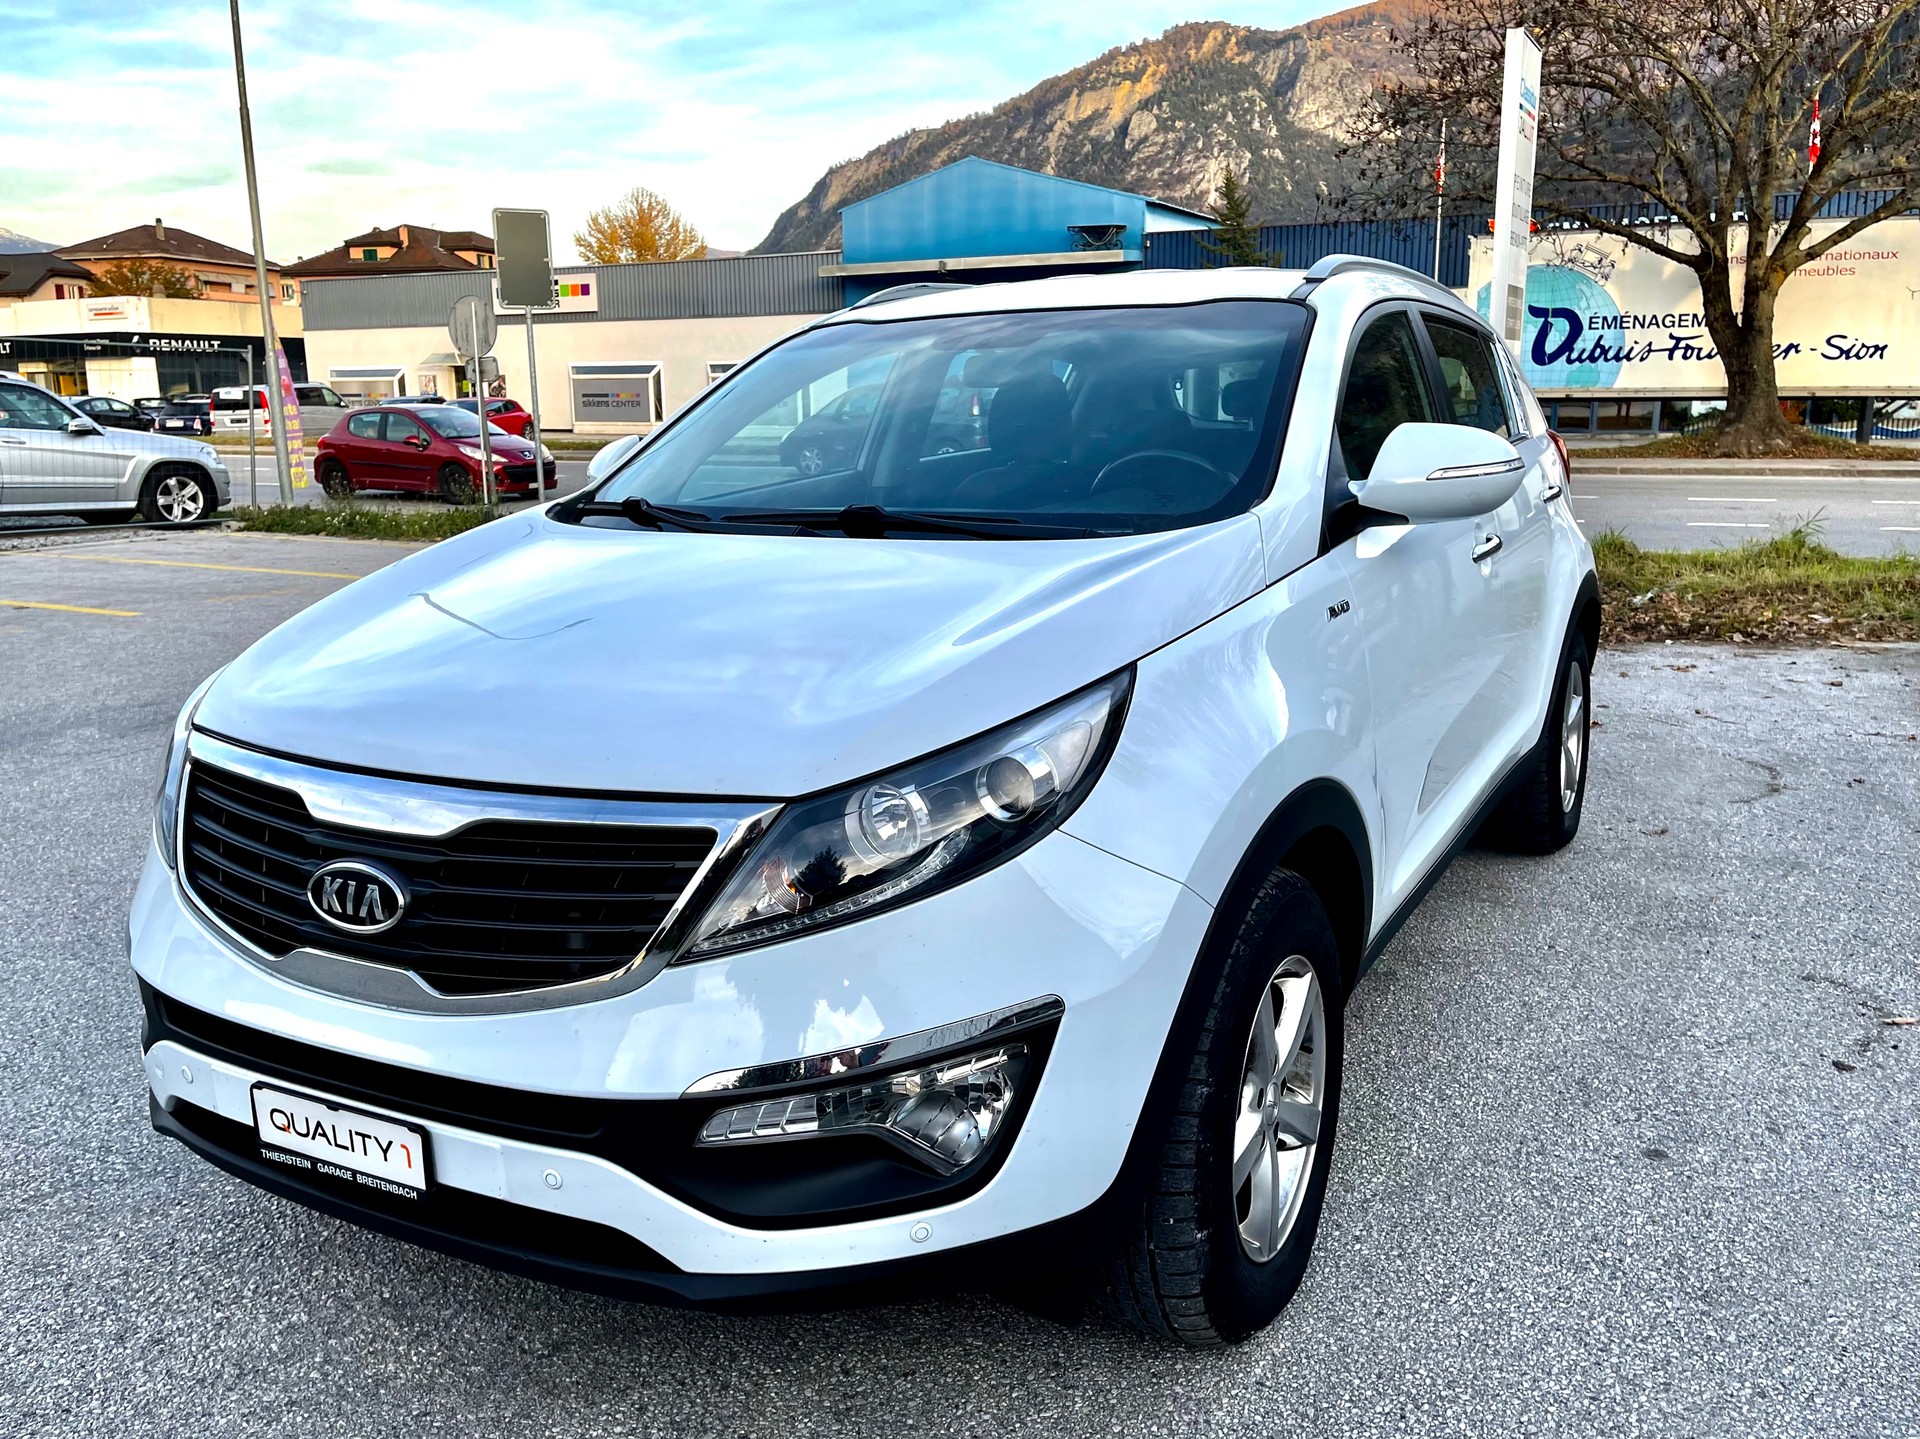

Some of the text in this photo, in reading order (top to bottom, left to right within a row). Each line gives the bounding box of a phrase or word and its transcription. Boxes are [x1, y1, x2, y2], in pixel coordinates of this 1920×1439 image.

[1812, 250, 1899, 262] rnationaux
[1793, 265, 1856, 277] meubles
[149, 339, 220, 352] RENAULT
[1528, 304, 1653, 366] Dubuis
[1667, 332, 1801, 361] Fouer
[1821, 334, 1889, 360] Sion
[582, 399, 641, 408] sikkens CENTER
[323, 876, 384, 920] KIA
[270, 1108, 393, 1162] QUALITY
[261, 1149, 417, 1200] THIERSTEIN GARAGE BREITENBACH
